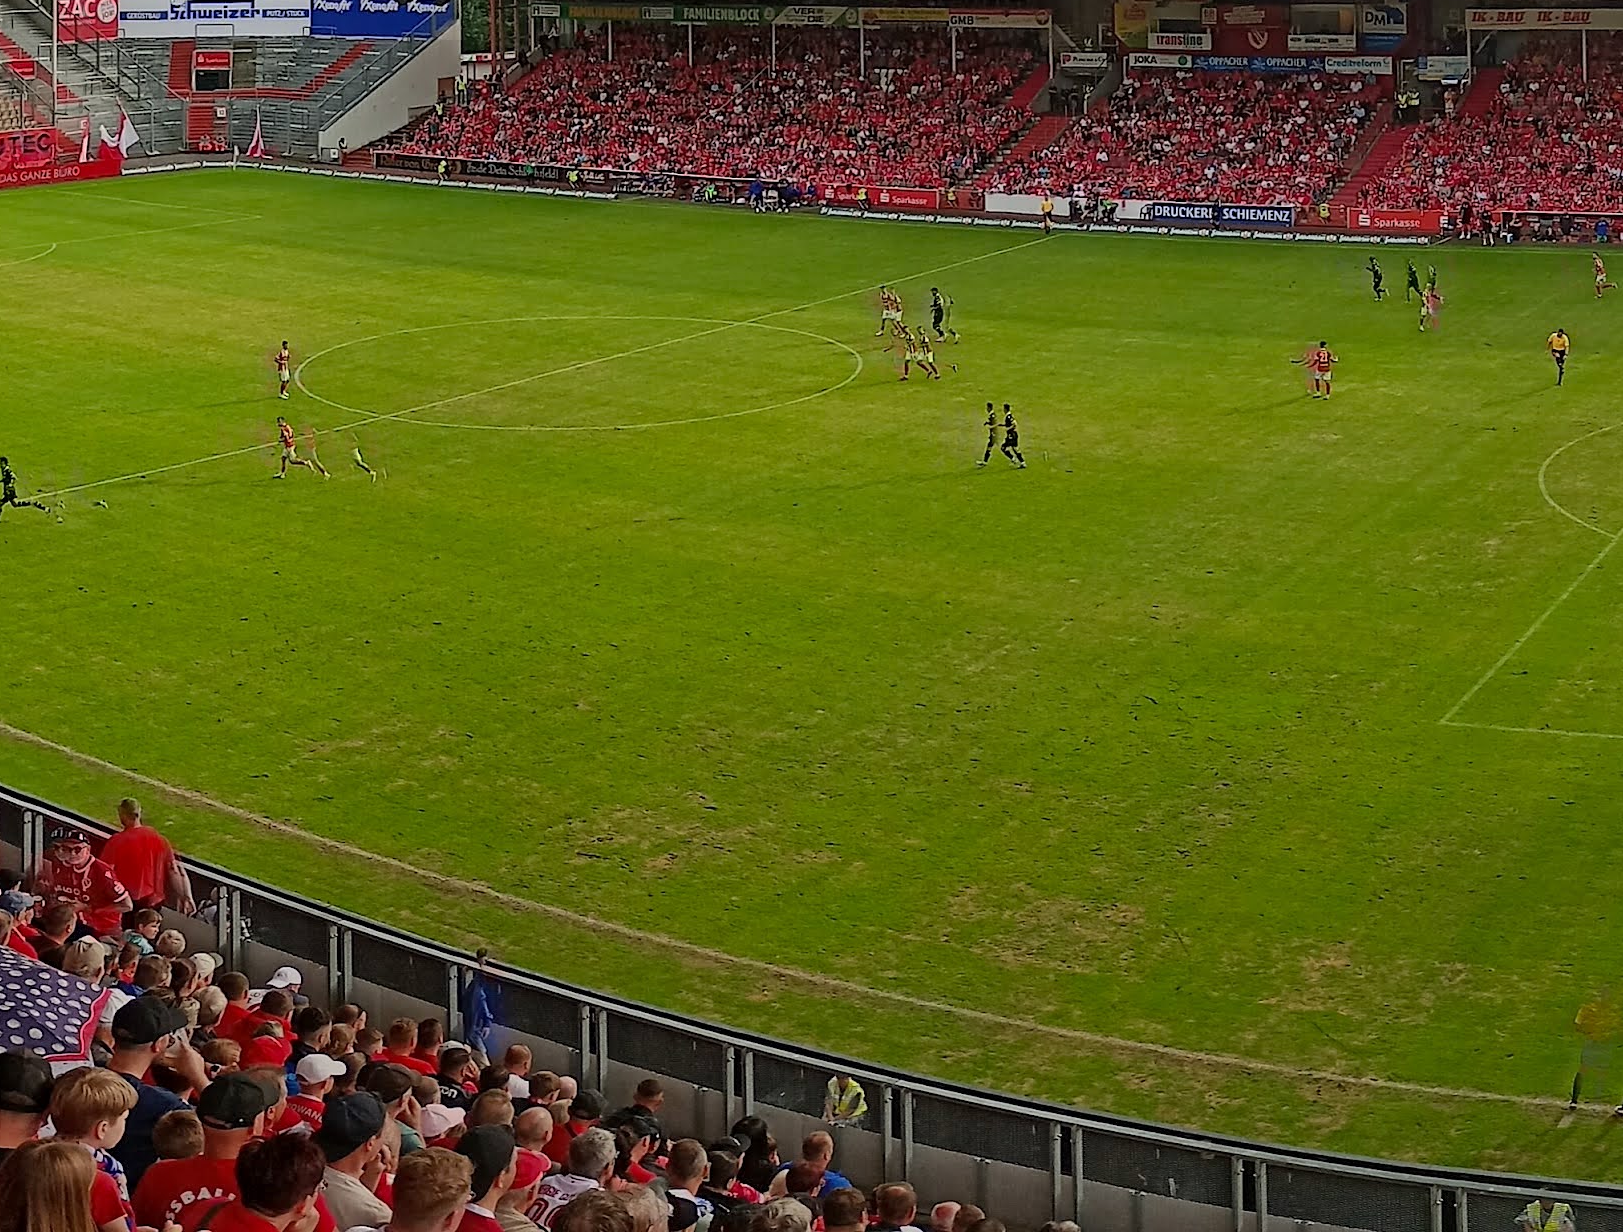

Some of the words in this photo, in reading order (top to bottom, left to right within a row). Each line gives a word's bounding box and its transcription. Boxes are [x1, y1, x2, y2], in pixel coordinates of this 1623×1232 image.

[58, 0, 97, 20] ZAC
[683, 7, 760, 21] FAMILIENBLOCK
[950, 15, 974, 25] GMB
[1133, 54, 1158, 65] JOKA
[1266, 57, 1307, 68] OPPACHER
[1326, 56, 1382, 68] Creditreform
[19, 169, 52, 183] GANZE
[891, 195, 927, 206] Sparkasse
[1222, 207, 1290, 223] SCHIEMENZ
[1374, 217, 1421, 229] Sparkasse
